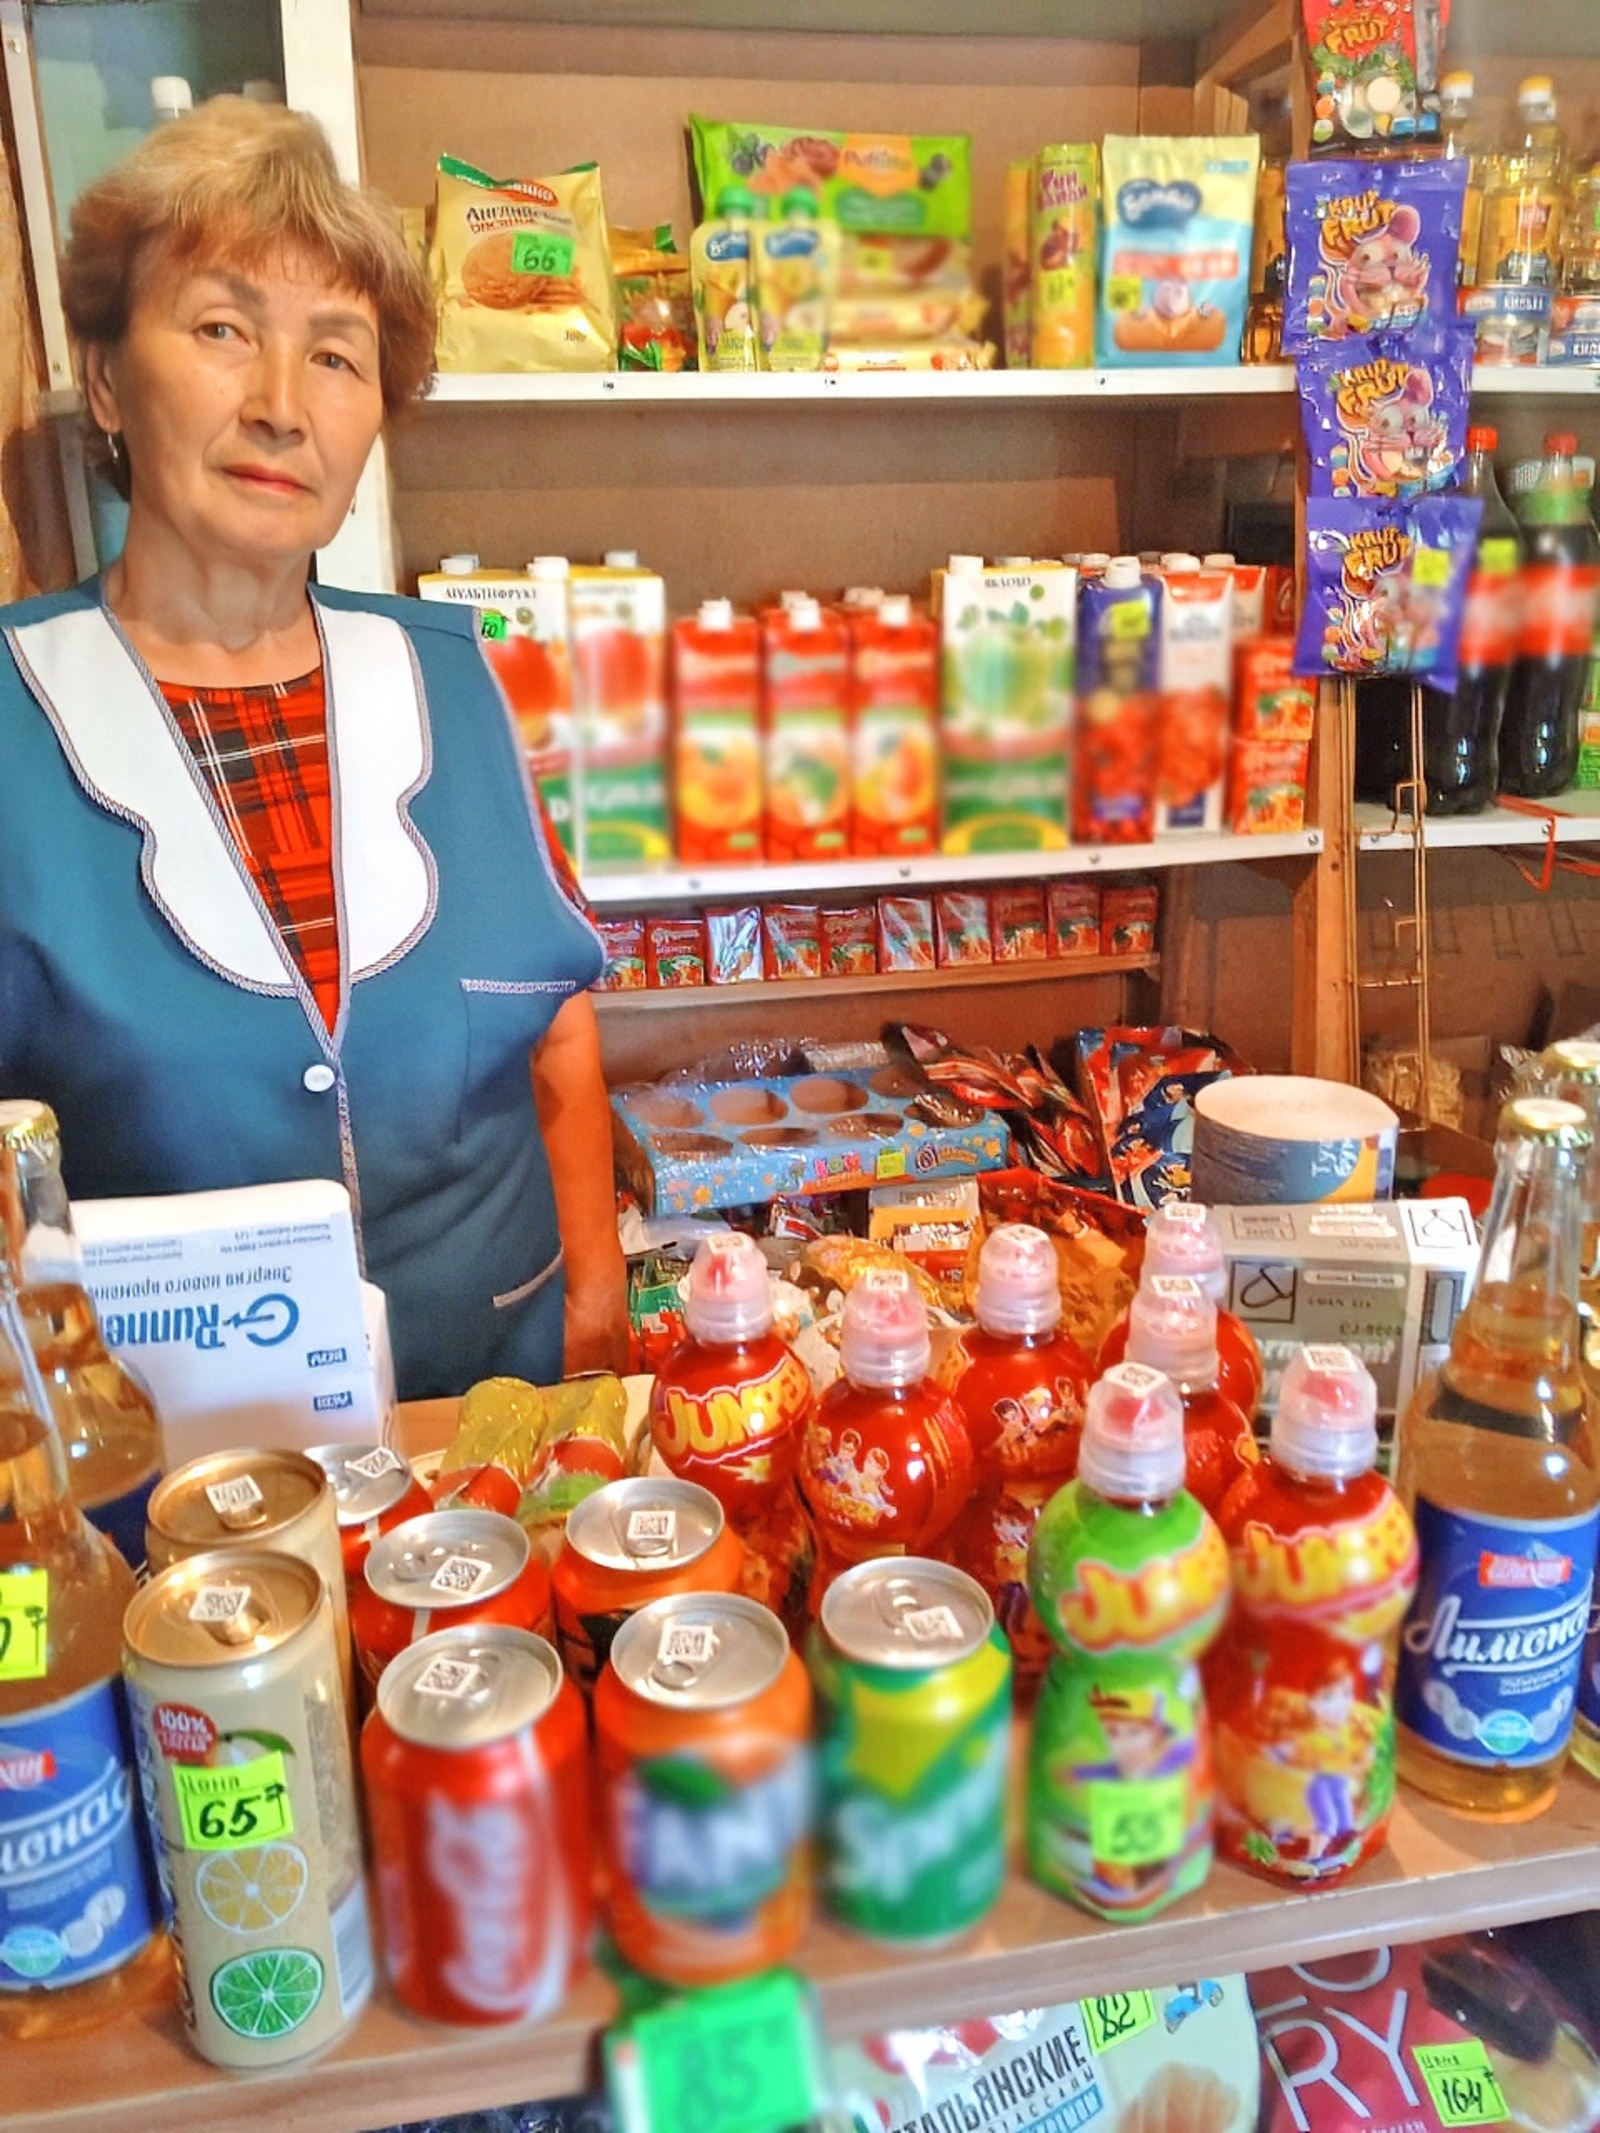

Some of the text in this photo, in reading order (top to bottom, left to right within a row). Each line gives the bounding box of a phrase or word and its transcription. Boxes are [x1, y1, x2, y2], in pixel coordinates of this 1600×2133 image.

[522, 247, 556, 271] 66
[86, 1277, 160, 1301] времен
[891, 2026, 1087, 2133] ТАЛЬЯНСКИЕ
